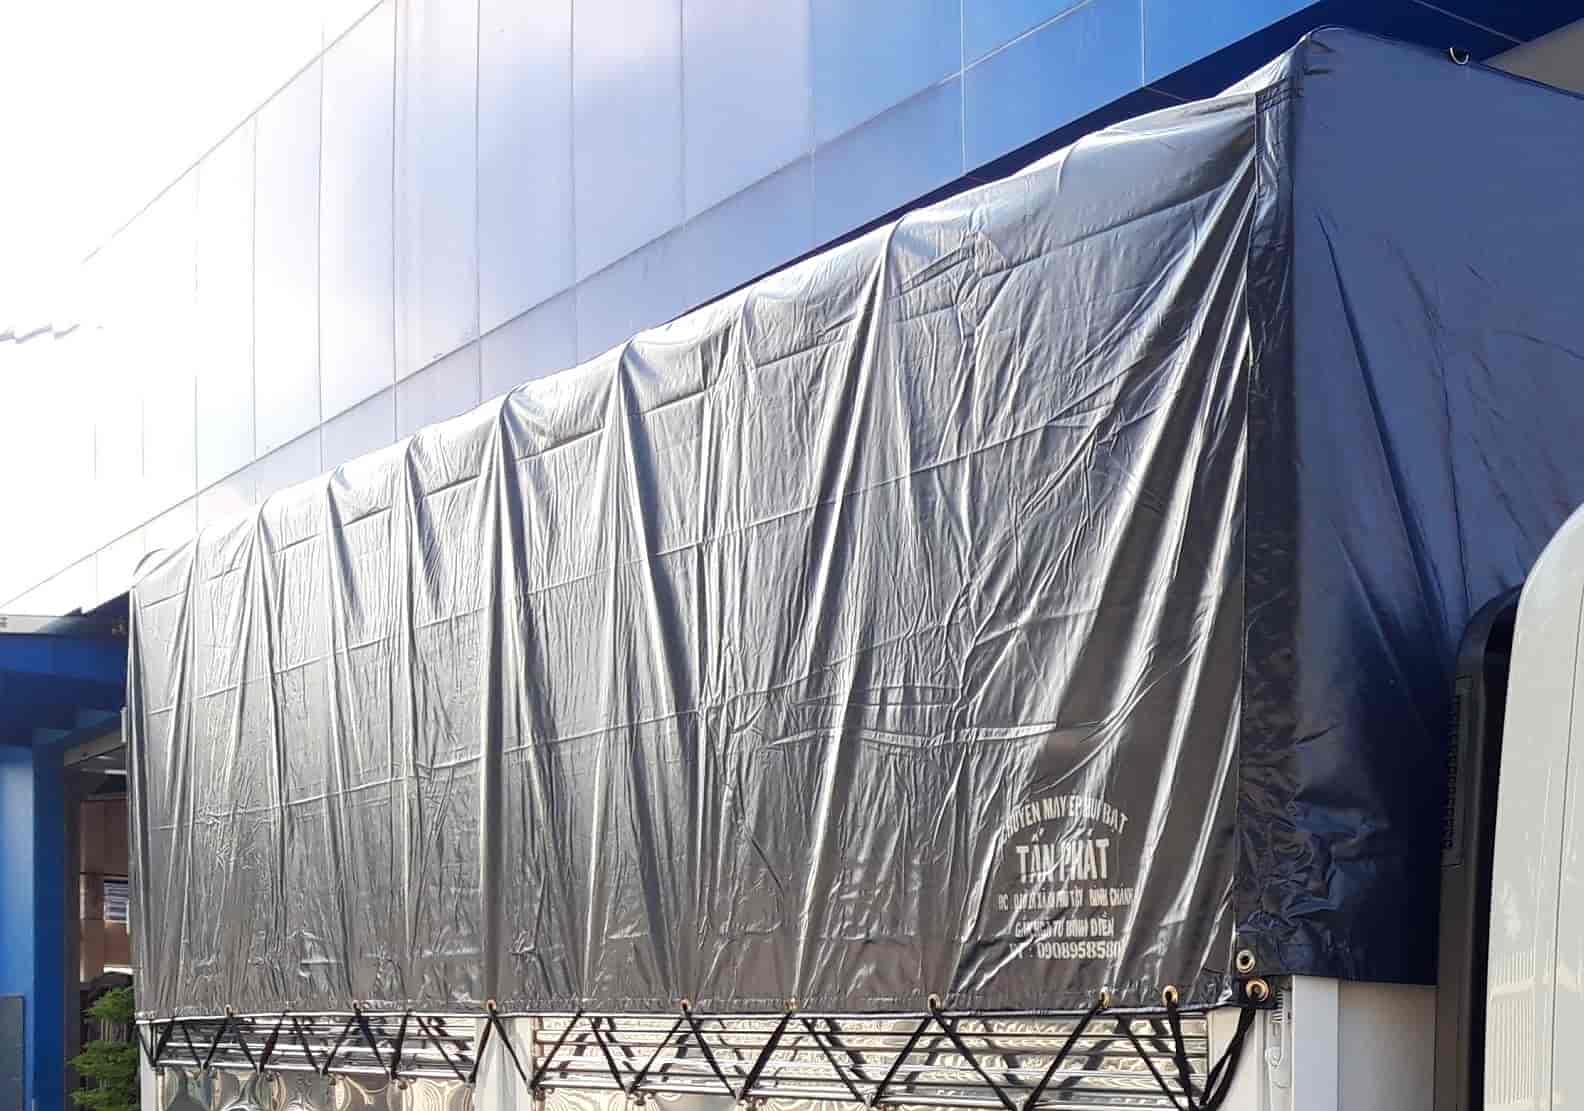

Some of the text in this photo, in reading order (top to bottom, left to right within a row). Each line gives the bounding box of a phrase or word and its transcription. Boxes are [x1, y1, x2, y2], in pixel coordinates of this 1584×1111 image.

[1102, 802, 1128, 834] BẠT
[1016, 828, 1110, 883] TẤN PHÁT
